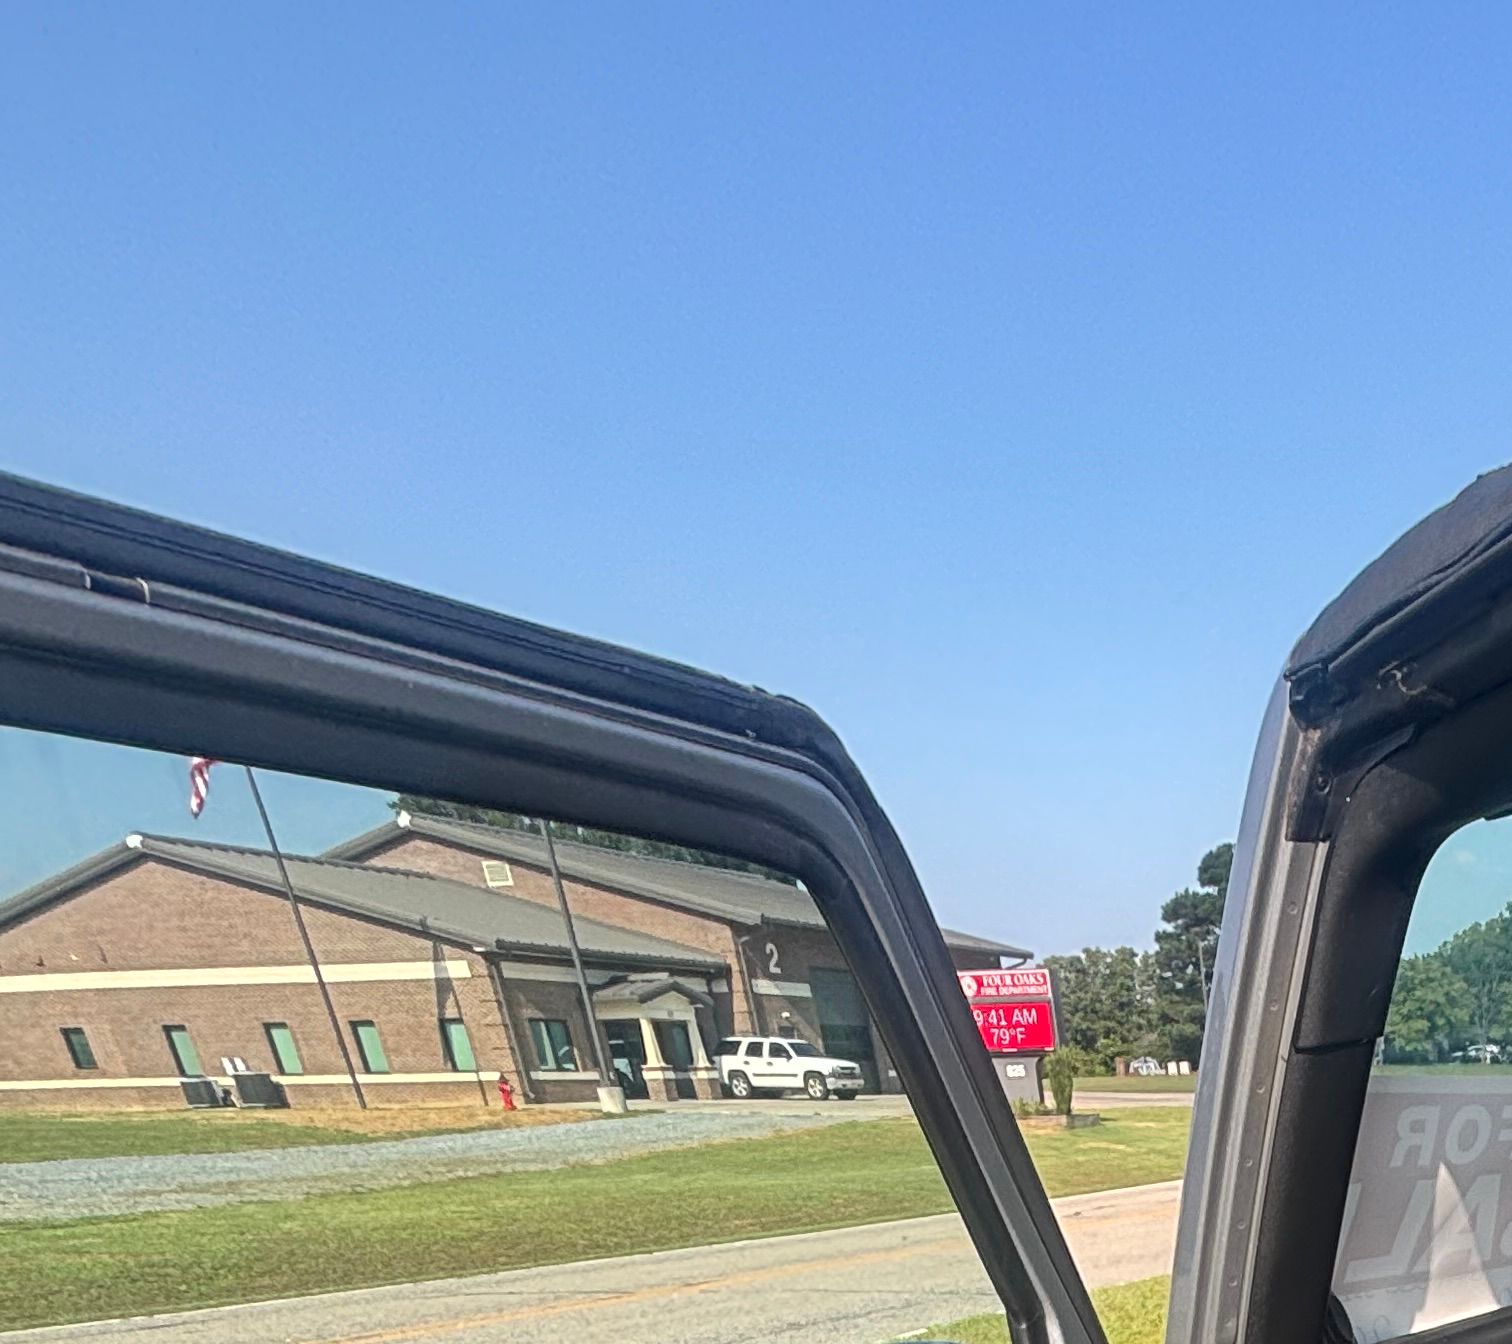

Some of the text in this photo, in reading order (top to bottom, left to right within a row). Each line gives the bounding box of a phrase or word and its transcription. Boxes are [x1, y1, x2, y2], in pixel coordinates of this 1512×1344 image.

[765, 942, 782, 974] 2
[982, 973, 1044, 986] FOUR OAKS
[1012, 1008, 1037, 1025] AM
[990, 1027, 1026, 1046] 79°F
